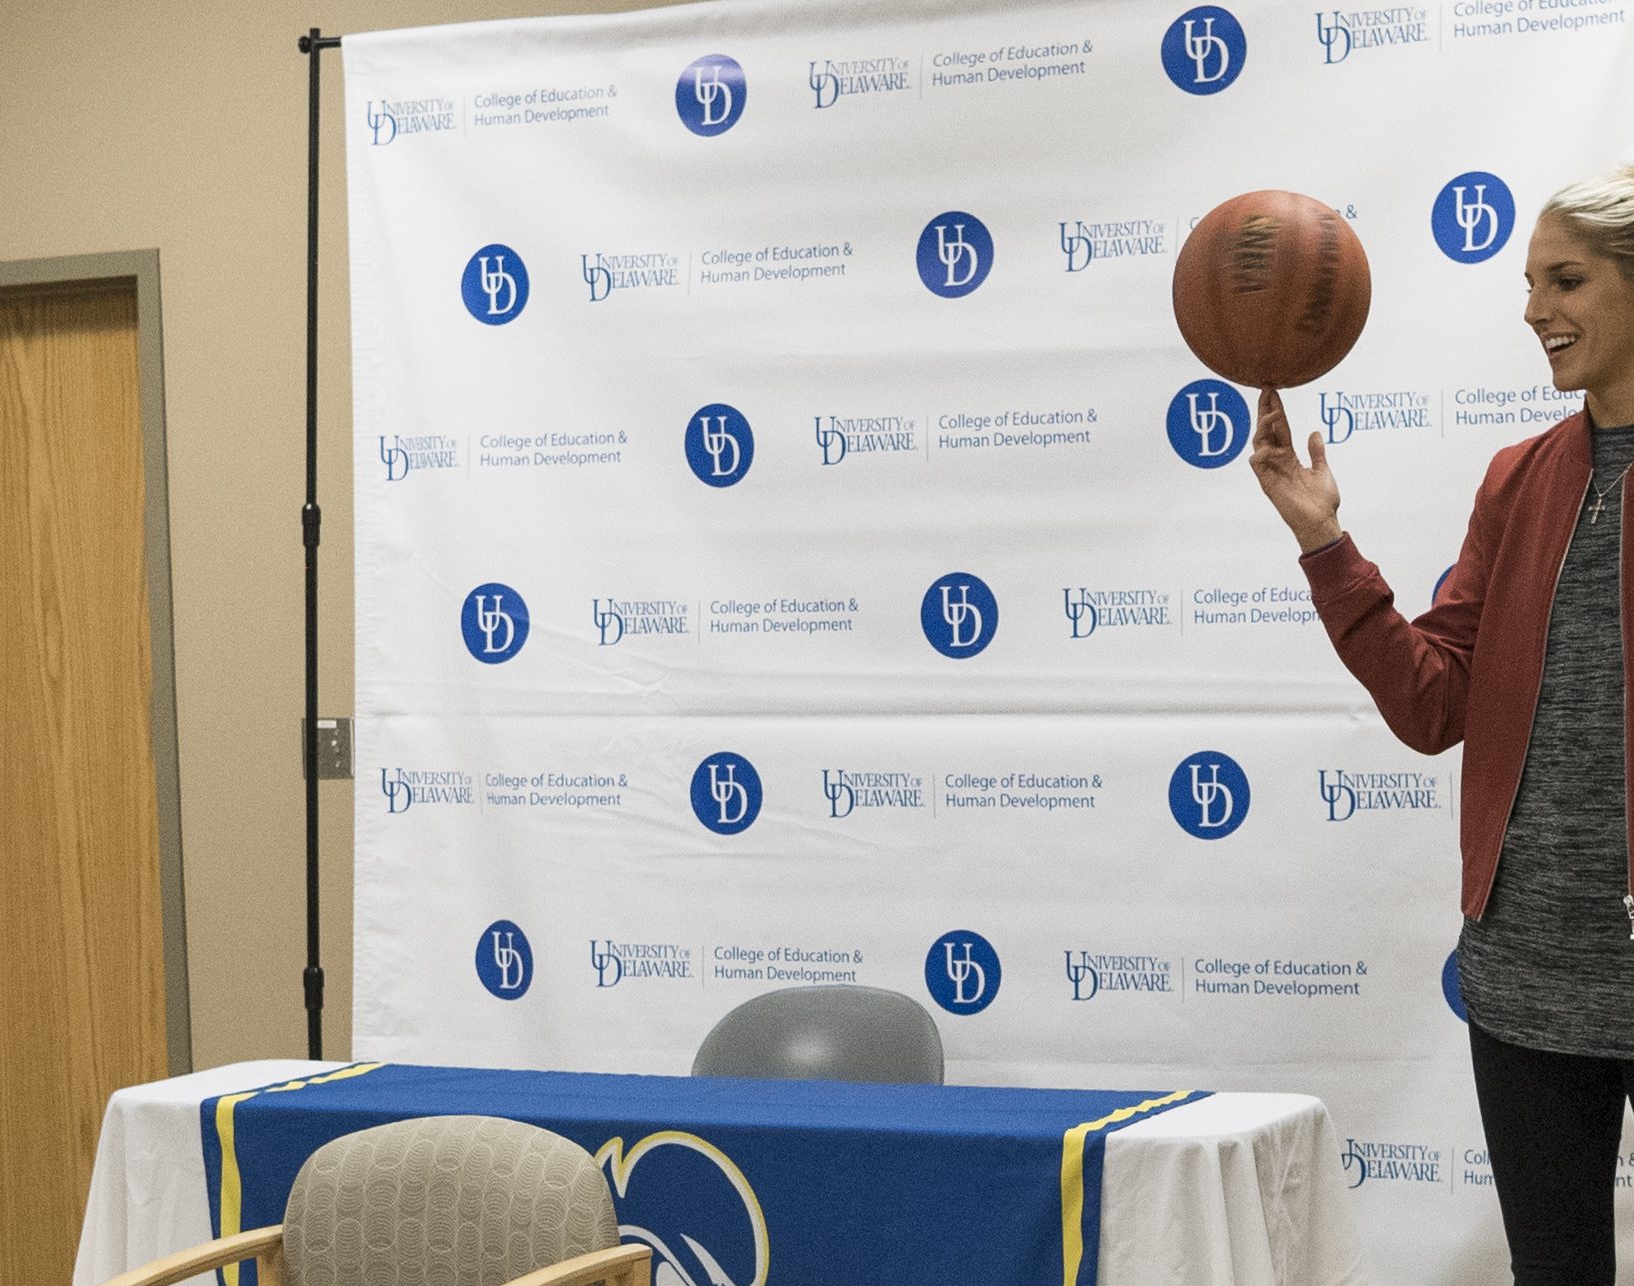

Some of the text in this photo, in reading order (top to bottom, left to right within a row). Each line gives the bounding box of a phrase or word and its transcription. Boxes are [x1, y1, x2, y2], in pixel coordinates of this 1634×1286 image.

[1454, 0, 1514, 18] College
[1317, 7, 1415, 46] UNIVERSITY
[1454, 9, 1625, 38] Human Development
[933, 40, 1093, 68] College of Education &
[809, 59, 896, 91] UNIVERSITY
[933, 61, 1085, 87] Human Development
[474, 84, 617, 110] College of Education &
[367, 99, 443, 129] UNIVERSITY
[475, 105, 609, 126] Human Development
[1346, 204, 1357, 219] &
[1059, 221, 1153, 254] UNIVERSITY
[702, 242, 853, 266] College of Education &
[581, 253, 670, 284] UNIVERSITY
[701, 264, 845, 283] Human Development
[1455, 389, 1516, 406] College
[1521, 386, 1536, 401] of
[1319, 392, 1416, 424] UNIVERSITY
[1456, 405, 1578, 425] Human Develo
[939, 409, 1097, 431] College of Education &
[480, 430, 627, 451] College of Education &
[814, 416, 902, 447] UNIVERSITY
[939, 430, 1090, 448] Human Development
[379, 435, 446, 464] UNIVERSITY
[480, 451, 620, 468] Human Development
[710, 598, 859, 616] College of Education &
[1062, 588, 1156, 620] UNIVERSITY
[1194, 589, 1248, 606] College
[1252, 588, 1266, 602] of
[592, 599, 676, 628] UNIVERSITY
[1194, 607, 1320, 625] Human Develop
[710, 619, 852, 634] Human Development
[381, 768, 465, 796] UNIVERSITY
[485, 774, 628, 789] College of Education &
[822, 770, 909, 800] UNIVERSITY
[946, 774, 1103, 791] College of Education &
[1318, 770, 1423, 803] UNIVERSITY
[487, 793, 620, 807] Human Development
[947, 794, 1095, 810] Human Development
[590, 941, 680, 970] UNIVERSITY
[714, 947, 863, 964] College of Education &
[715, 966, 856, 983] Human Development
[1064, 951, 1157, 983] UNIVERSITY
[1195, 958, 1367, 977] College of Education &
[1195, 980, 1360, 997] Human Development
